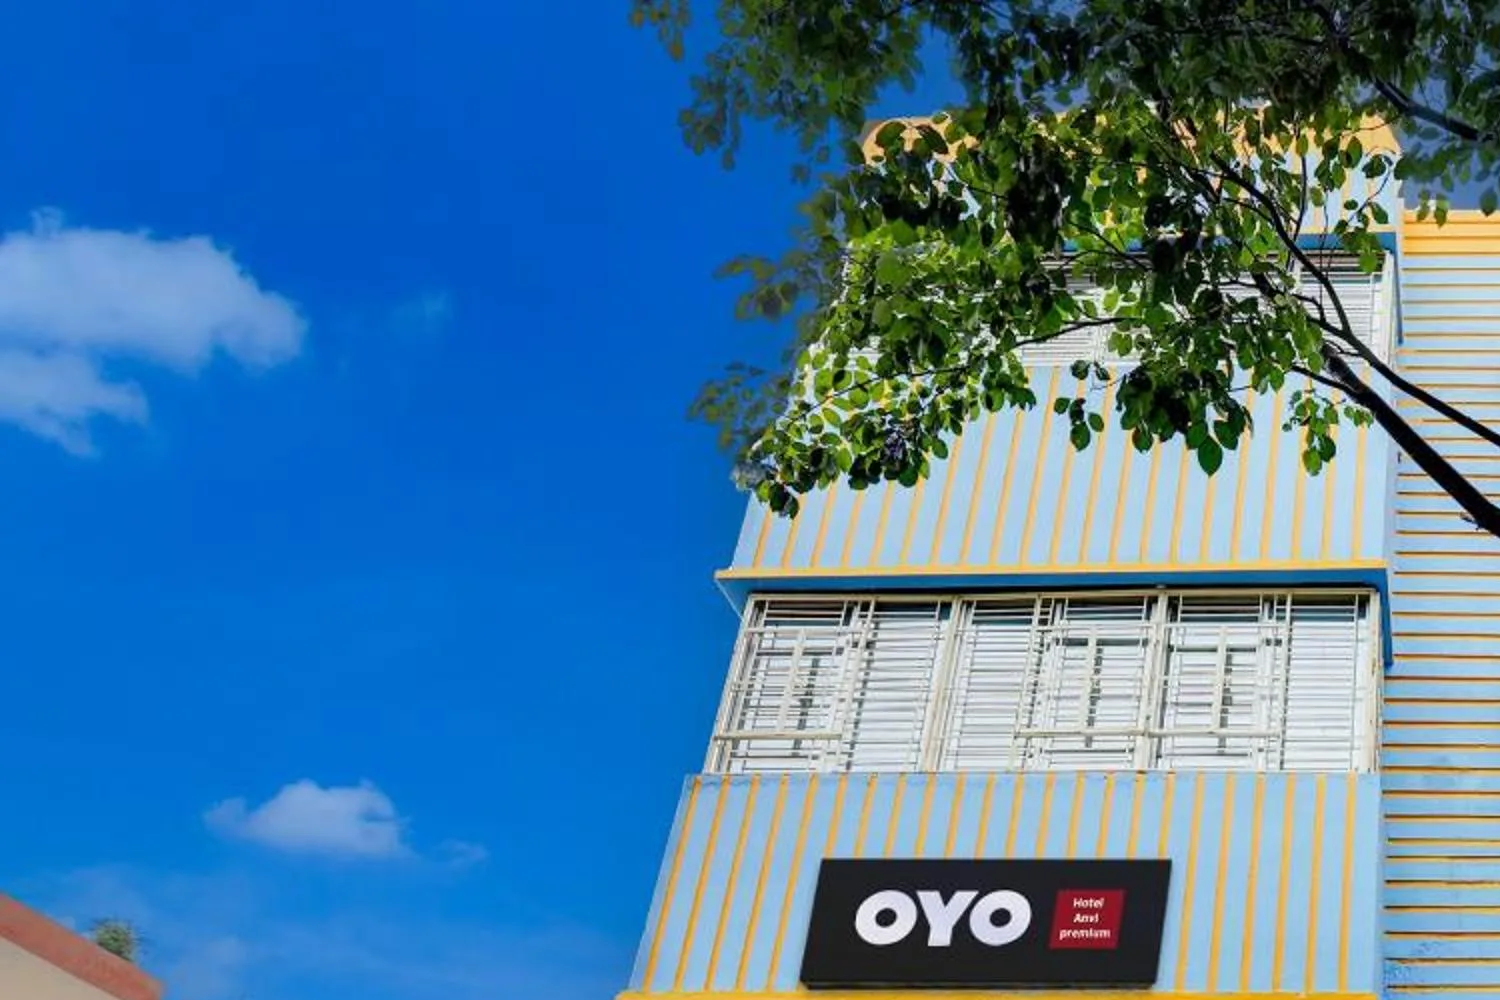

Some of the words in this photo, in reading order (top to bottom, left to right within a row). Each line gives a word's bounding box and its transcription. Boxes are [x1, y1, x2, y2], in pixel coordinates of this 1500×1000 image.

[1073, 897, 1105, 908] Hotel
[854, 888, 1032, 947] OYO
[1059, 928, 1111, 940] premium
